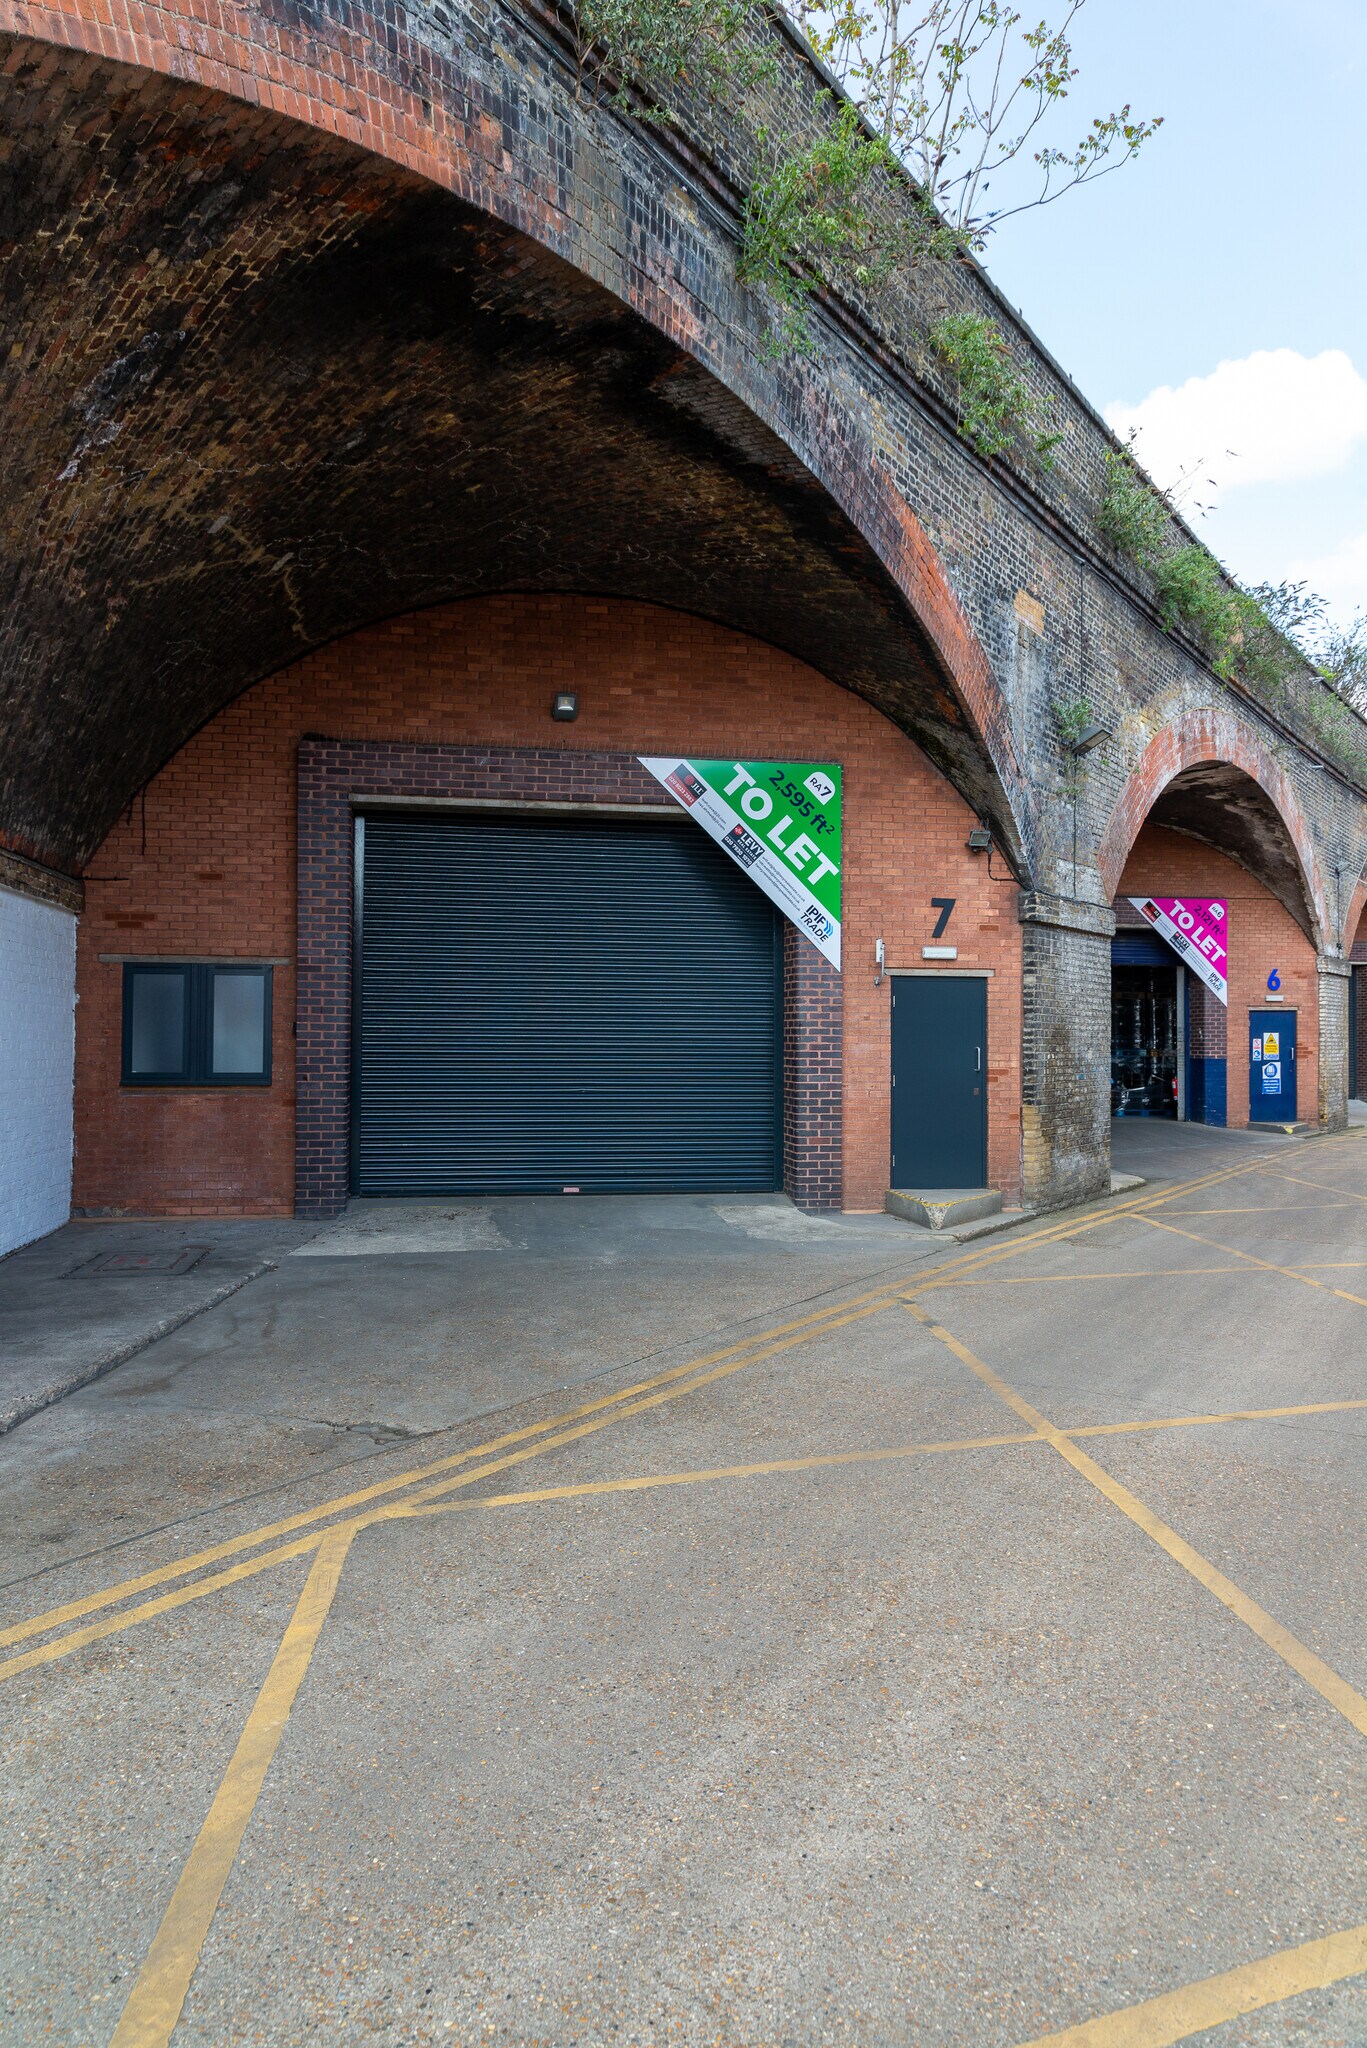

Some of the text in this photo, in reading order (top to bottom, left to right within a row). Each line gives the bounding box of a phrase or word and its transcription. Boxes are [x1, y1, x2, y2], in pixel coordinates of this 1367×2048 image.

[690, 782, 703, 795] JLL
[769, 770, 815, 817] 2,595
[810, 777, 832, 796] RA7
[723, 763, 773, 820] TO
[767, 814, 840, 885] LET
[737, 839, 745, 848] REAL
[744, 847, 756, 860] ESTATE
[740, 832, 763, 856] LEVY
[805, 904, 827, 924] IPIF
[931, 897, 956, 938] 7
[1194, 905, 1214, 926] 2,121
[800, 912, 828, 942] TRADE
[1169, 899, 1194, 929] TO
[1191, 926, 1227, 962] LET
[1207, 976, 1221, 991] TRADE
[1267, 968, 1281, 991] 6
